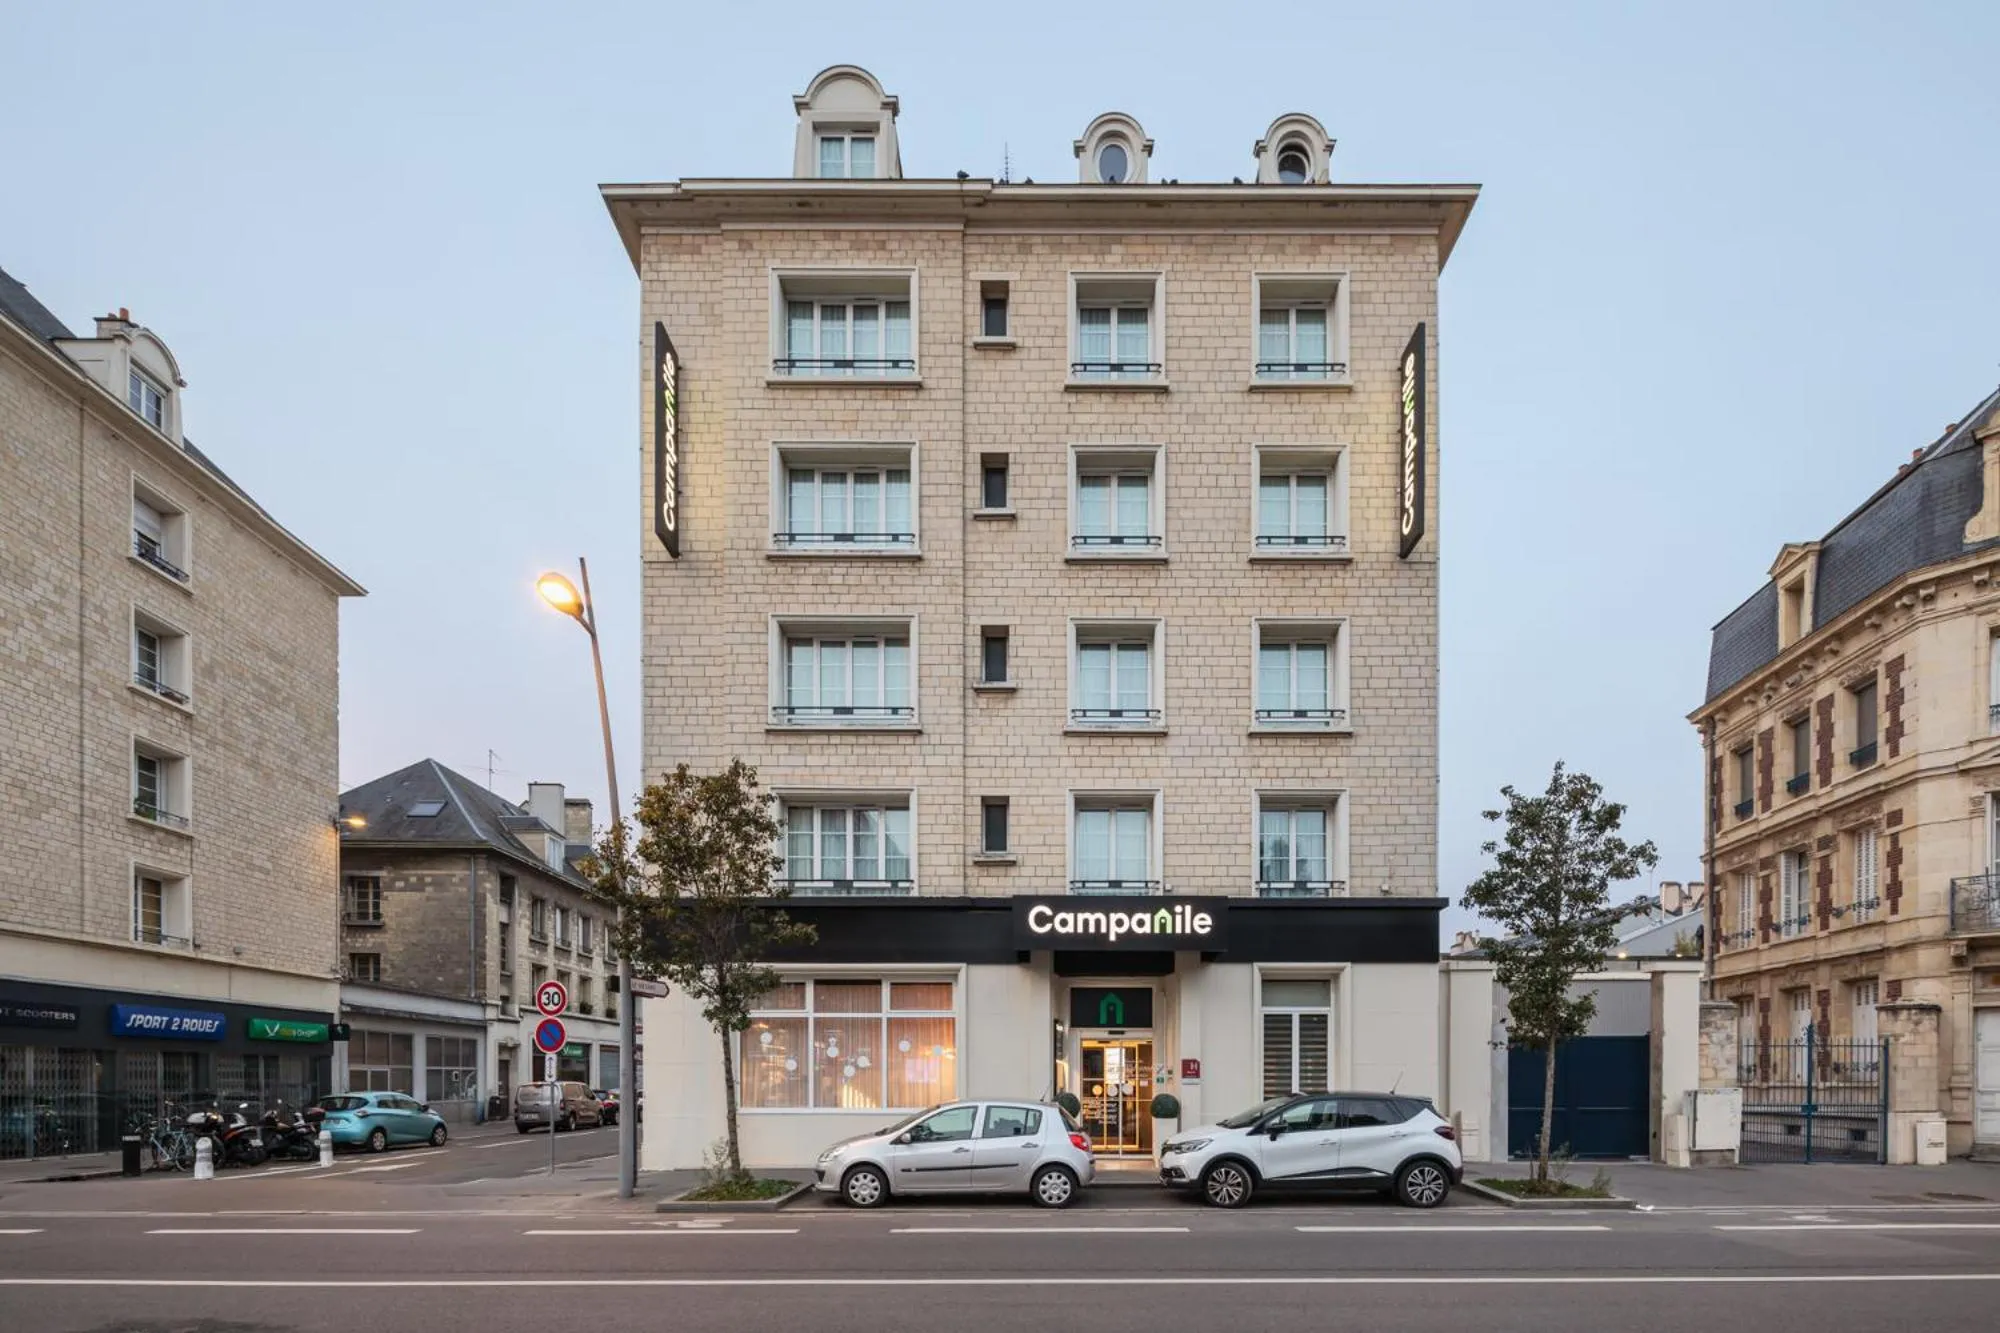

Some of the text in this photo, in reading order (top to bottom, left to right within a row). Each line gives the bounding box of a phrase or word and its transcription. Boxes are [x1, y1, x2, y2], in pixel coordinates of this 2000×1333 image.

[663, 352, 677, 531] Campanile
[1402, 353, 1417, 535] Campanile
[1028, 905, 1212, 941] Campanile
[543, 991, 561, 1007] 30
[16, 1009, 76, 1022] SCOOTERS
[125, 1013, 220, 1033] SPORT 2 ROUES
